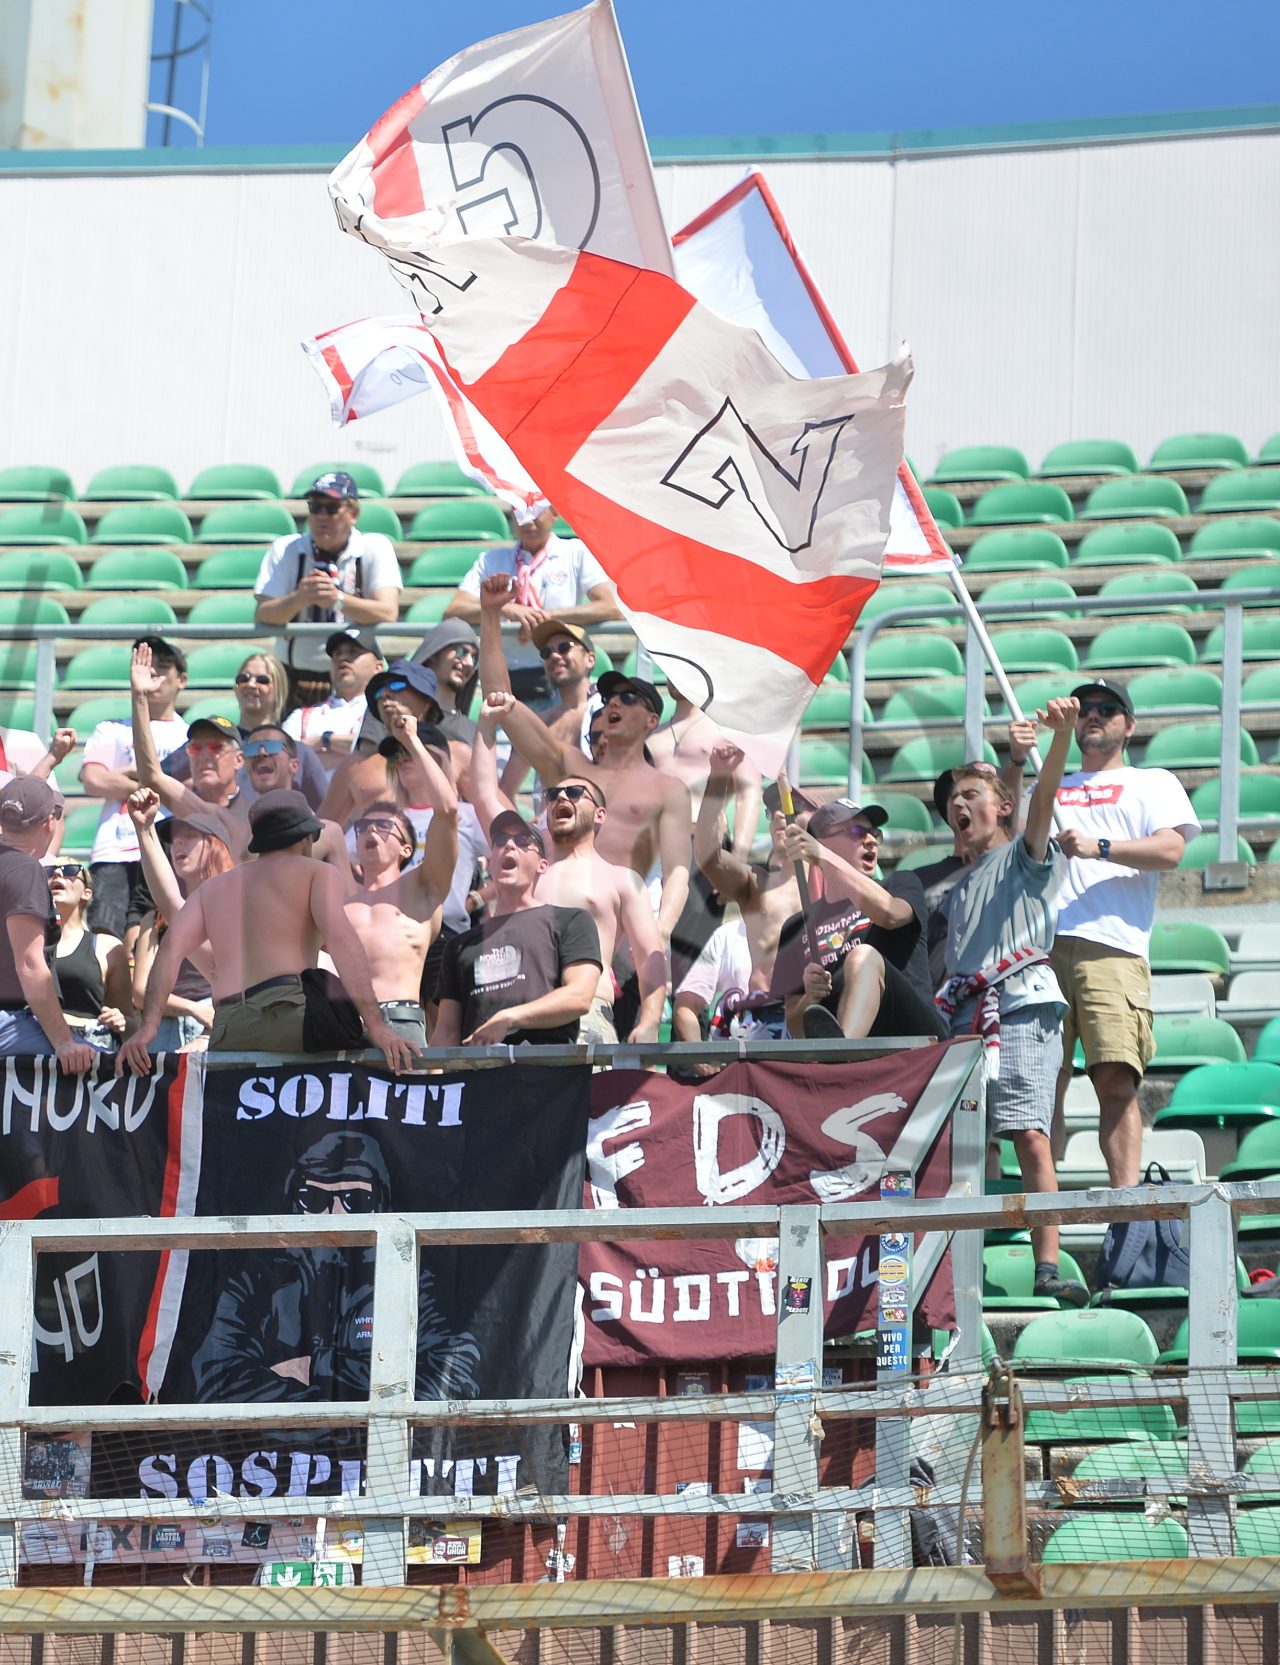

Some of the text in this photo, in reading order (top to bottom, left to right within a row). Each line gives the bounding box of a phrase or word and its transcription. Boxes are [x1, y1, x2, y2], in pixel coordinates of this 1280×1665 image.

[236, 1072, 467, 1127] SOLITI
[589, 1246, 881, 1324] SÜDTIOL
[354, 1316, 373, 1325] WHIT
[355, 1331, 373, 1339] ARM
[882, 1333, 903, 1343] VIVO
[883, 1344, 901, 1354] PER
